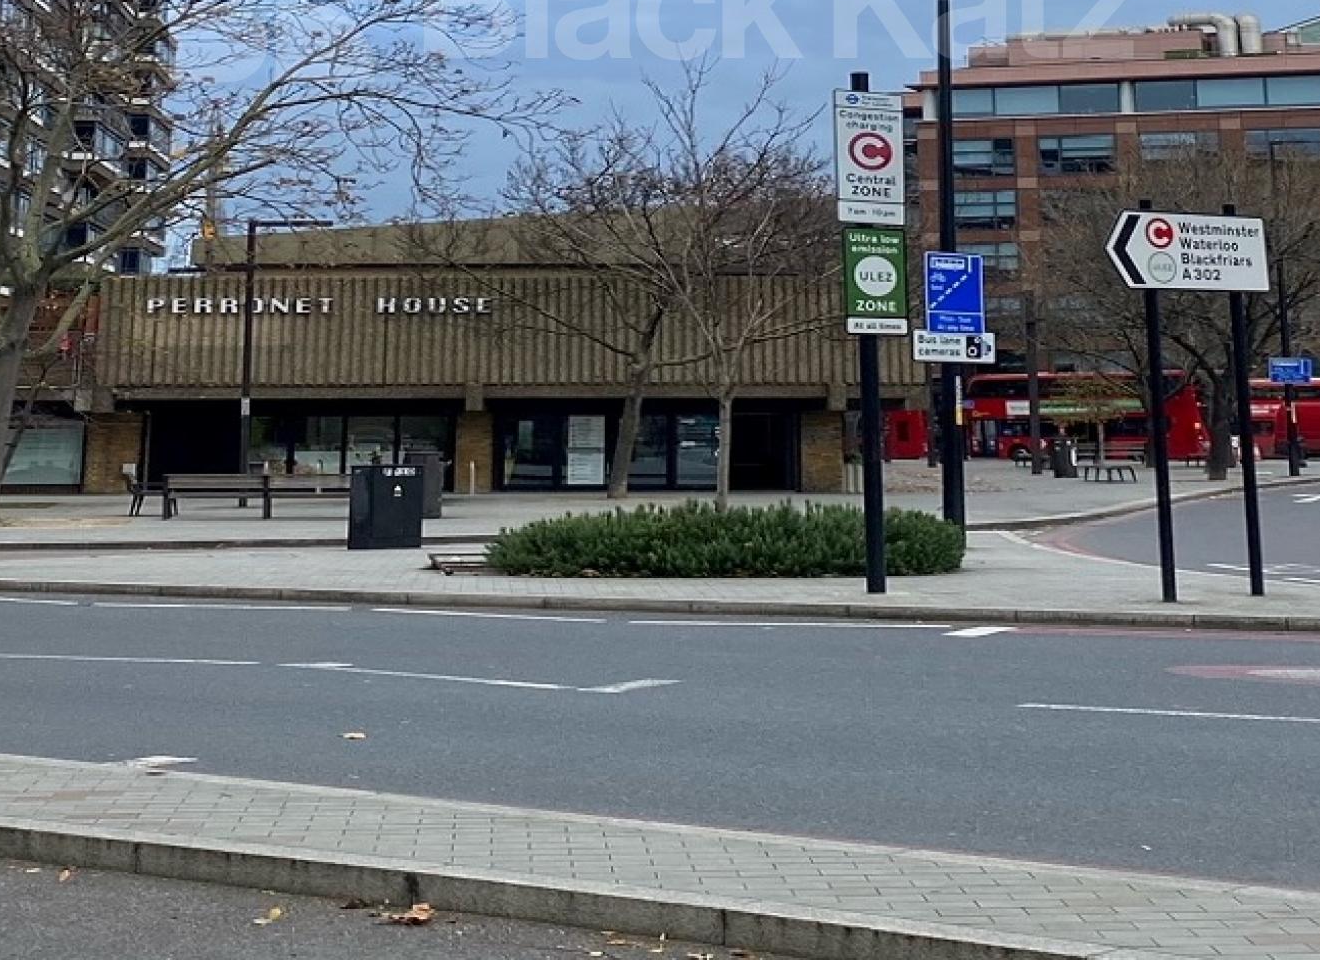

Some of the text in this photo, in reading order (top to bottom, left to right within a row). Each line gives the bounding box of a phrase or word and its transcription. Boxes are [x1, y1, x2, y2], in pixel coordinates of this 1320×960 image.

[839, 109, 898, 122] Congestion
[845, 121, 893, 133] charging
[846, 173, 896, 186] Central
[851, 186, 891, 198] ZONE
[1179, 222, 1259, 238] Westminster
[849, 232, 899, 244] Ultra low
[851, 244, 898, 254] emission
[1180, 238, 1239, 252] Waterloo
[1181, 252, 1253, 267] Blackfriars
[859, 271, 893, 283] ULEZ
[1182, 268, 1221, 281] A302
[377, 297, 493, 314] HOUSE
[856, 299, 897, 313] ZONE
[918, 334, 961, 345] Bus lane
[919, 347, 961, 357] cameras
